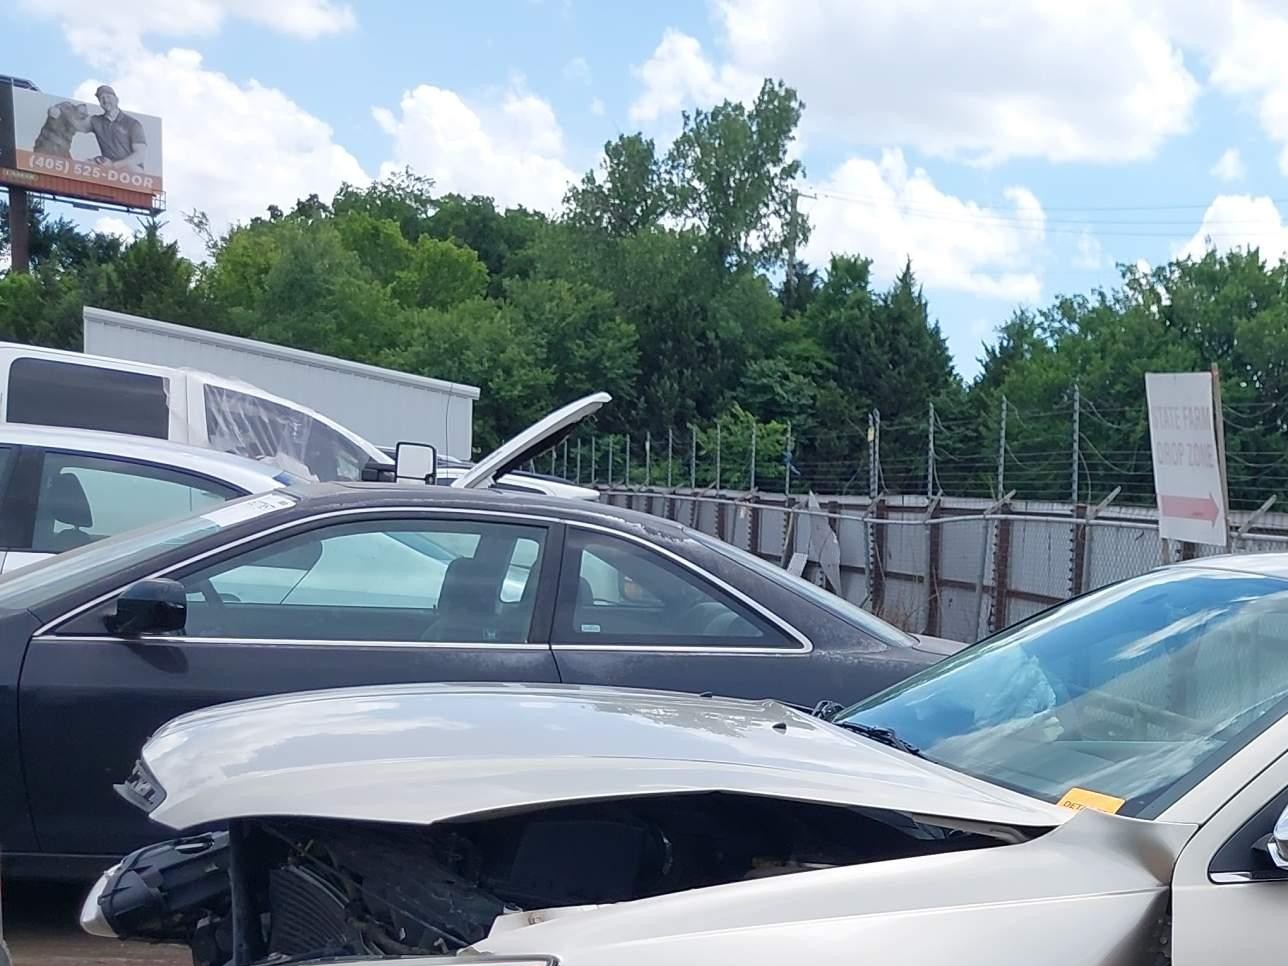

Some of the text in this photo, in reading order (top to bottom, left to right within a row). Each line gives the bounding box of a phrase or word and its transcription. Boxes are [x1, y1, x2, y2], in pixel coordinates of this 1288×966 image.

[29, 155, 153, 188] (405) 525-DOOR
[1151, 406, 1211, 431] STATE FARM
[1157, 441, 1215, 468] DROP ZONE
